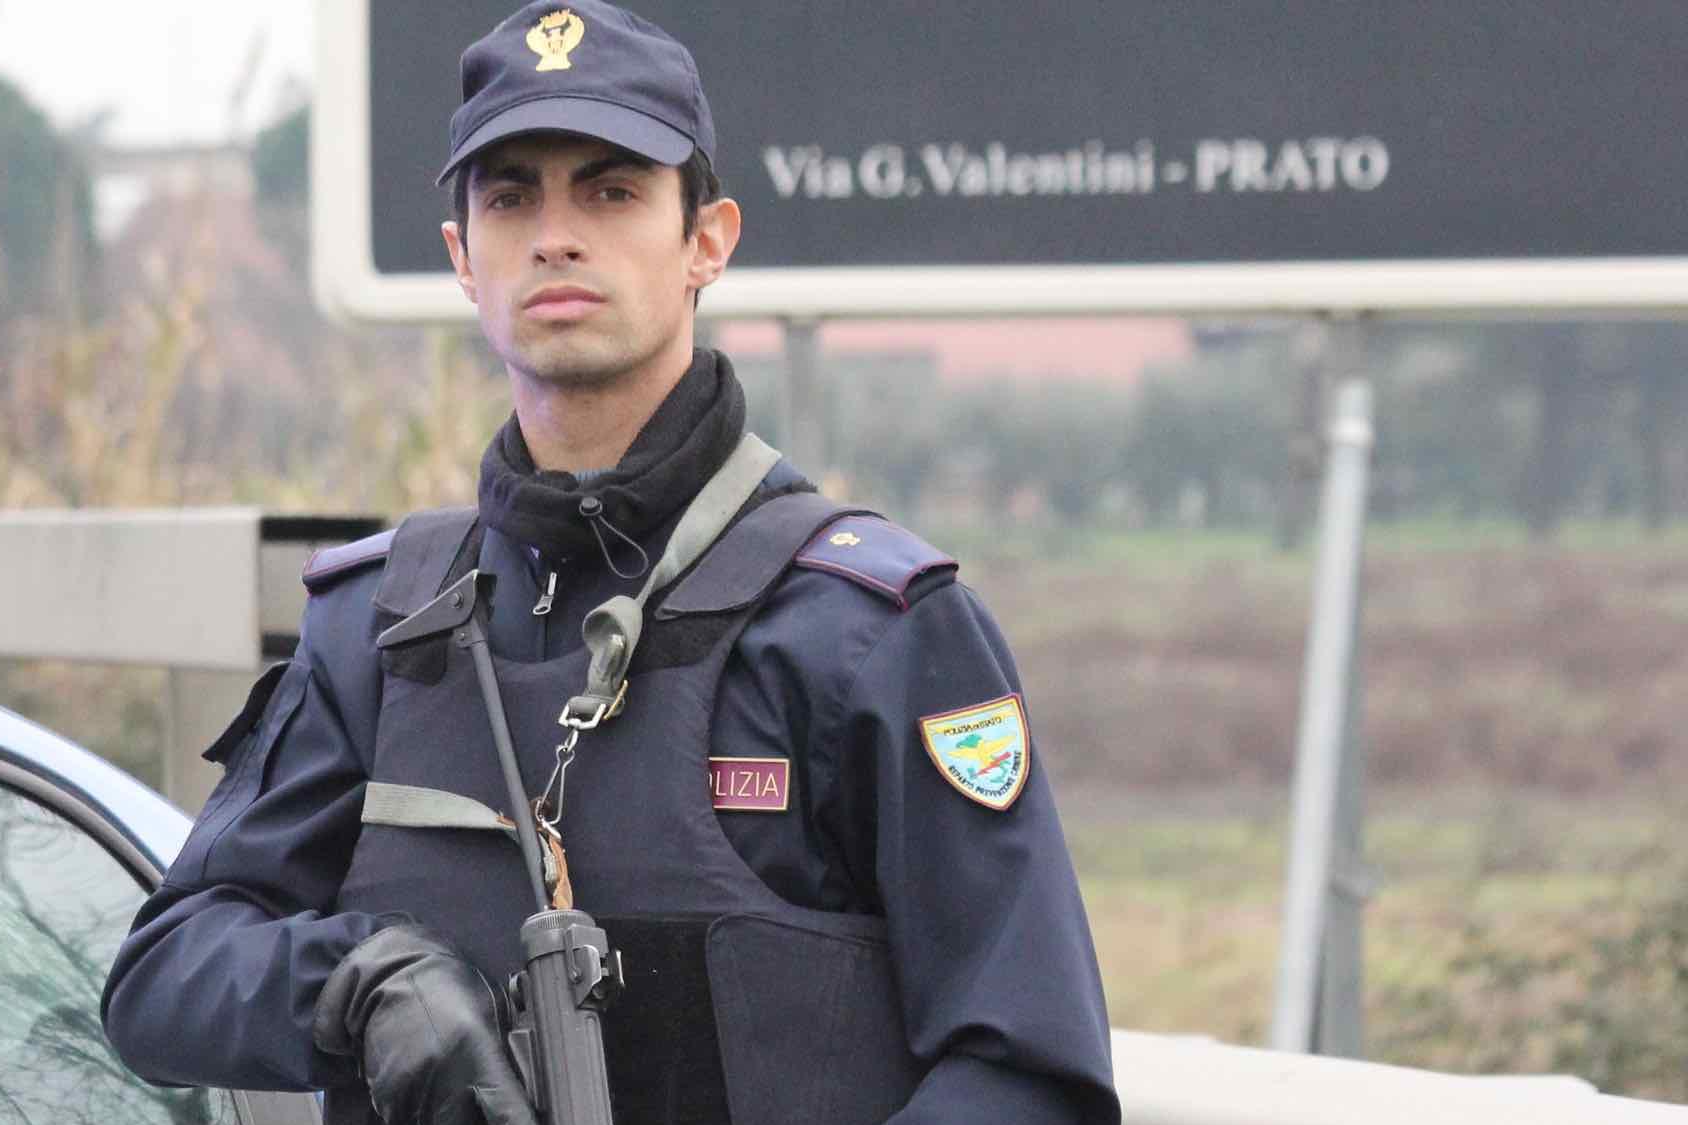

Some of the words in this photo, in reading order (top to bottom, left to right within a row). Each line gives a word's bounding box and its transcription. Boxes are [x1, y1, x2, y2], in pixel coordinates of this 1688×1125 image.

[763, 145, 853, 198] Via
[1196, 136, 1392, 192] PRATO
[709, 771, 779, 797] LIZIA
